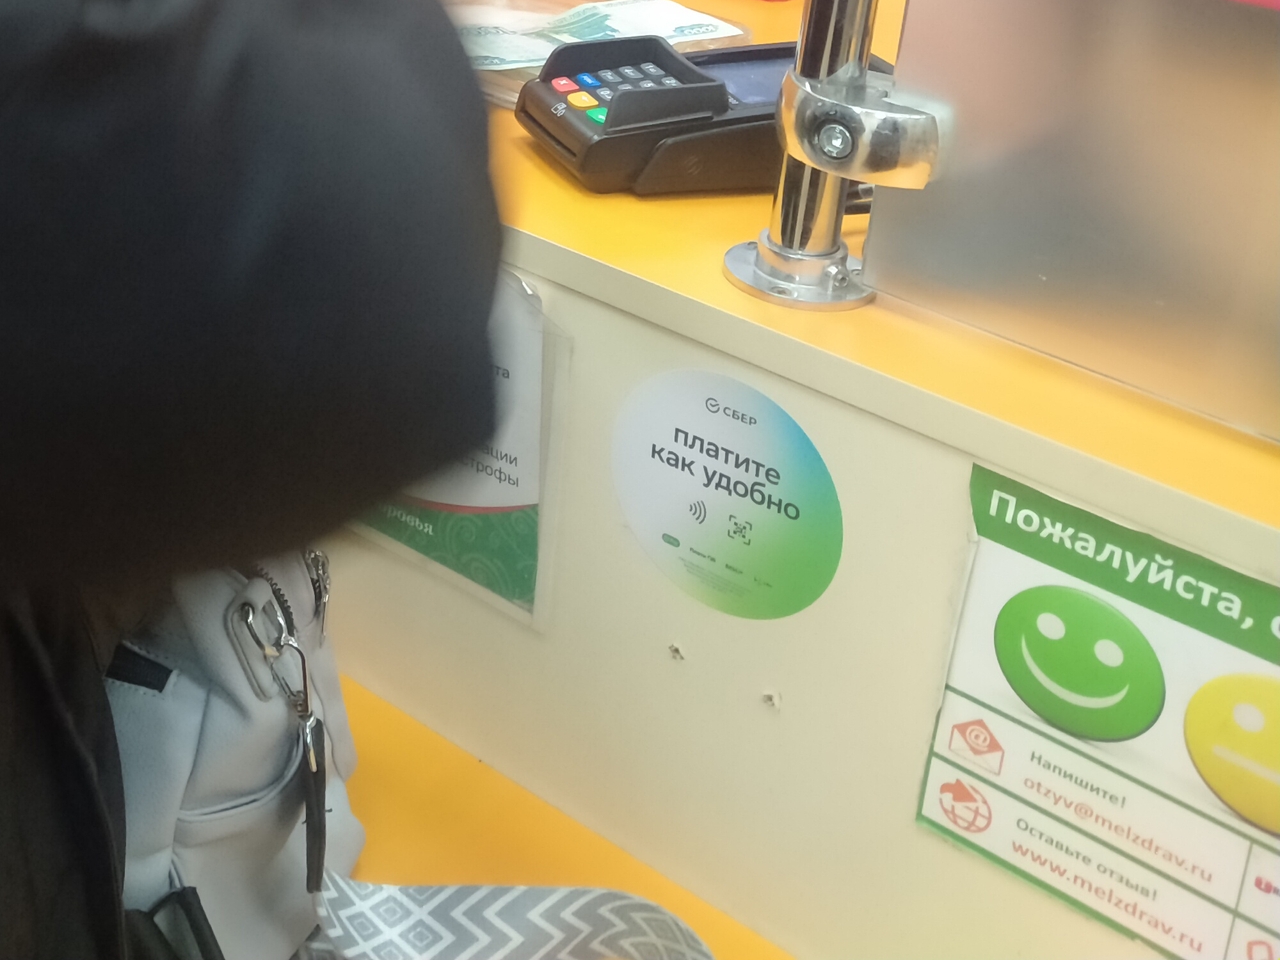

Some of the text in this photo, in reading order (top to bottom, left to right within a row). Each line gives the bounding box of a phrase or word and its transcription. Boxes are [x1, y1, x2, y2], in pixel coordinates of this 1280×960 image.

[481, 443, 519, 468] ации
[722, 405, 758, 427] СБЕР
[650, 442, 801, 521] как удобно
[673, 427, 782, 486] платите
[988, 488, 1255, 631] Пожалуйста,
[1029, 750, 1128, 810] Напишите!
[1015, 817, 1160, 902] Оставьте отзыв!
[1022, 775, 1214, 884] otzyv@melzdrav.ru
[1010, 839, 1204, 955] www.melzdrav.ru
